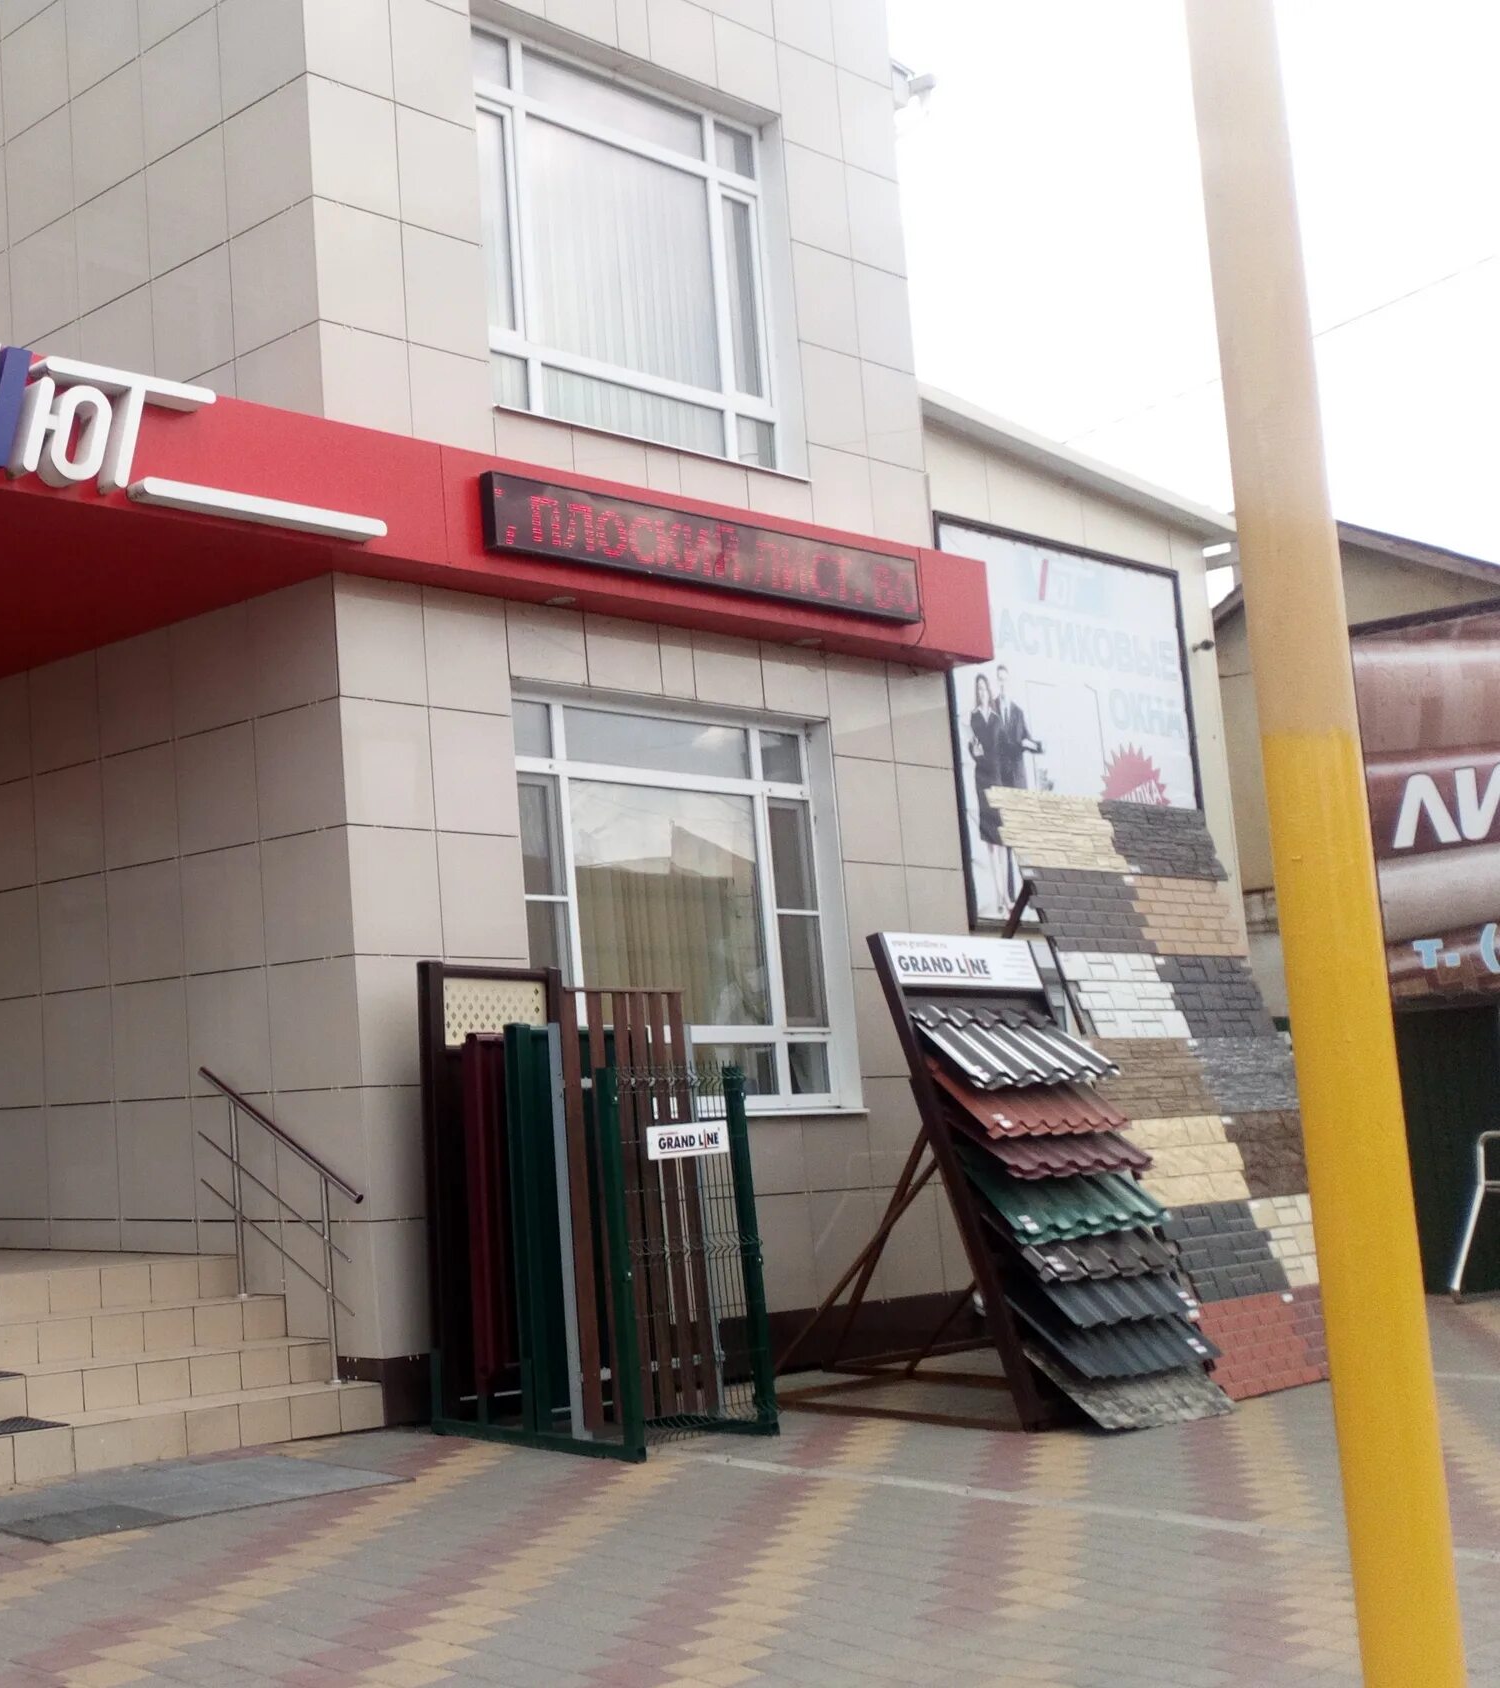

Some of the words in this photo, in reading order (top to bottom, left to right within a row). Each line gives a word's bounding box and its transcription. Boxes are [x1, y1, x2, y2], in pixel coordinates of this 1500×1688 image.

[997, 608, 1179, 683] АСТИКОВЫЕ
[897, 954, 953, 974] GRAND
[658, 1135, 696, 1150] GRAND
